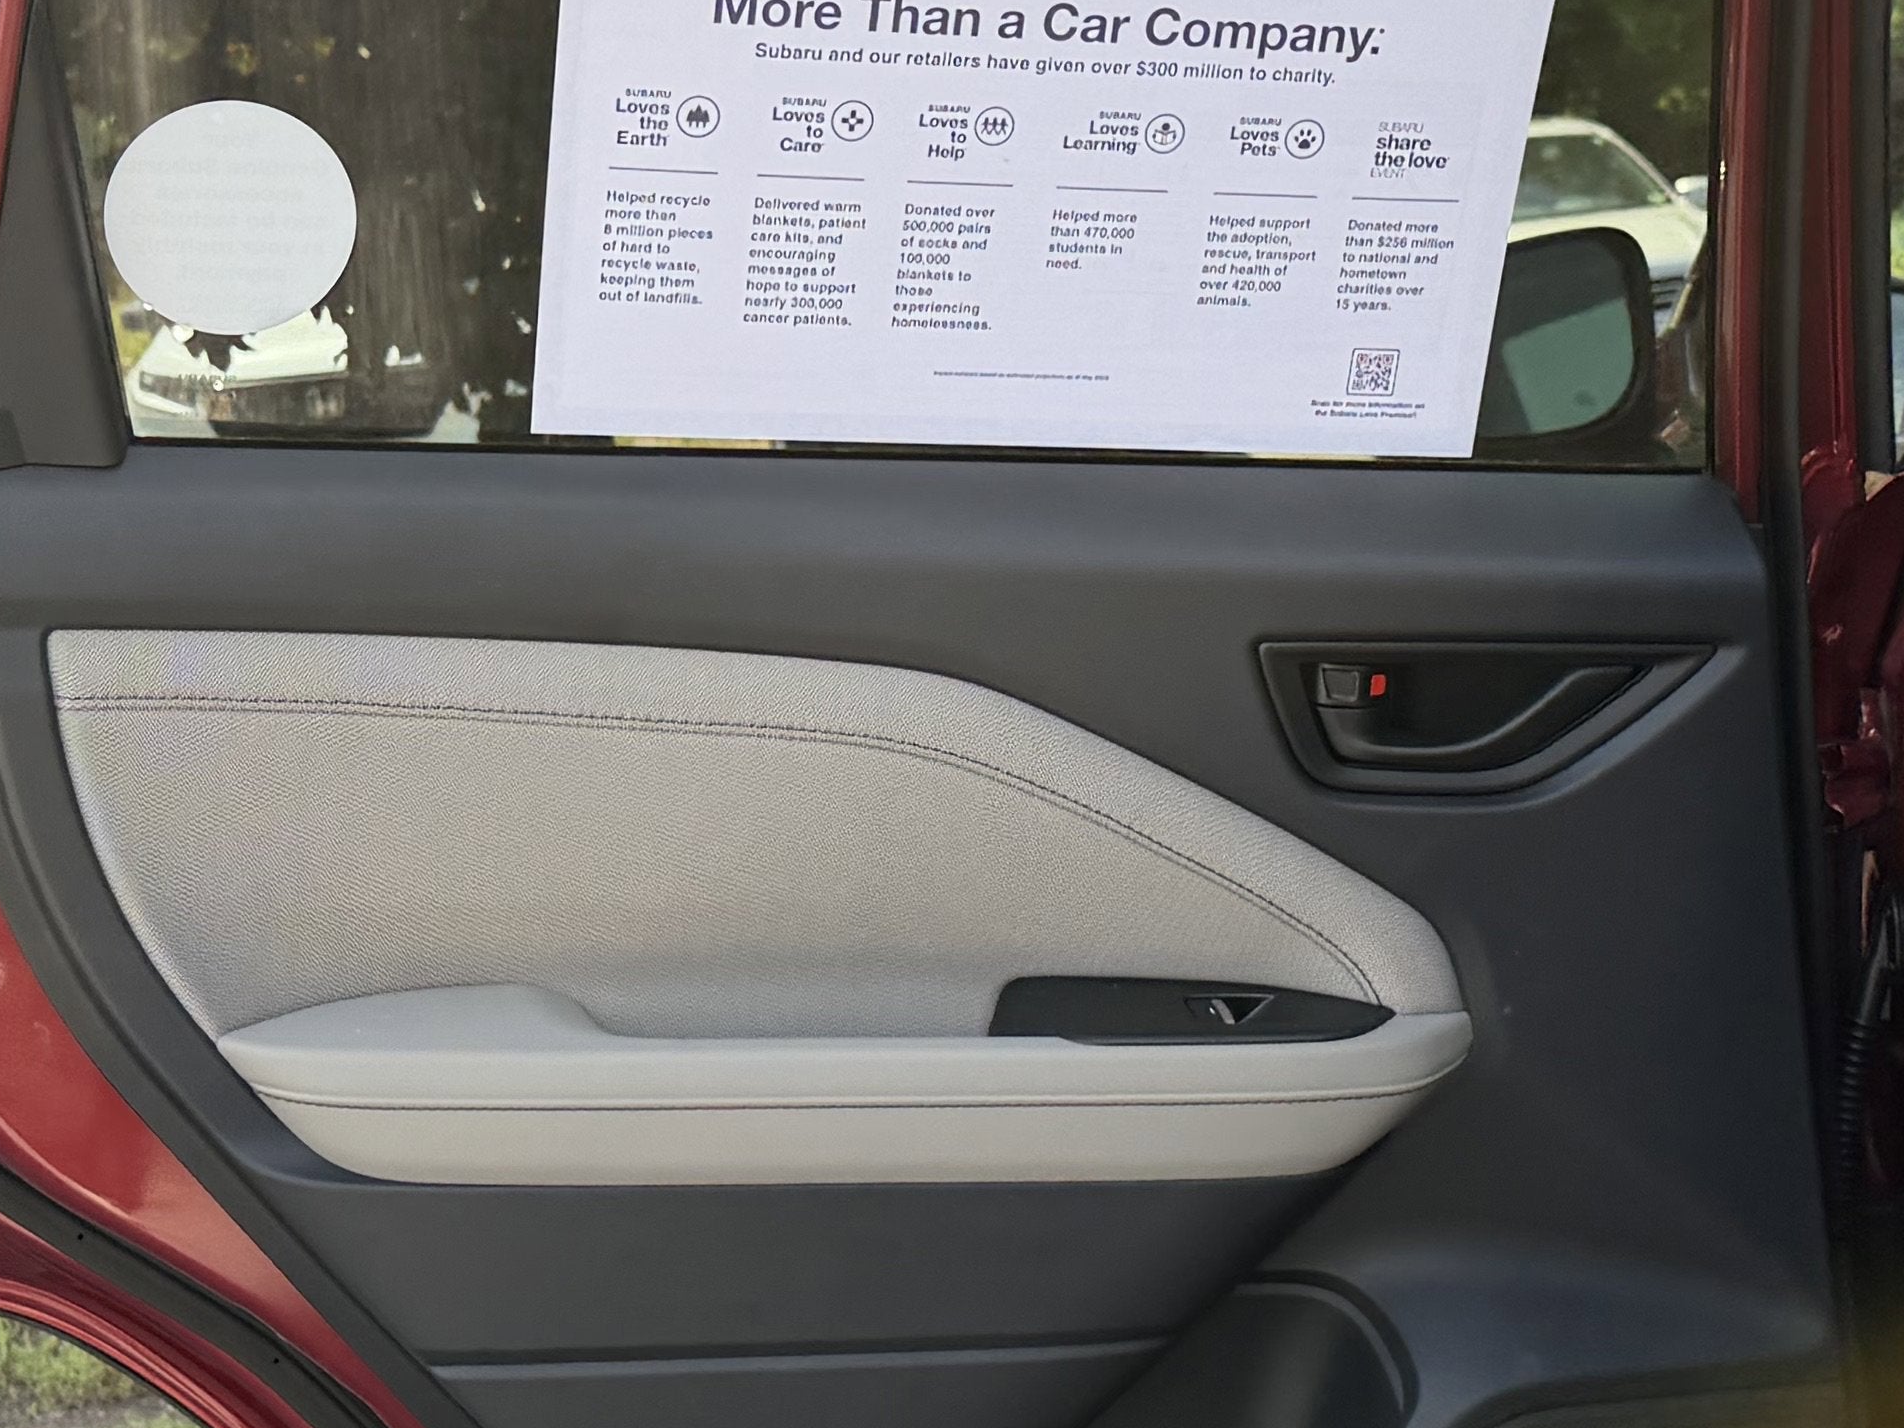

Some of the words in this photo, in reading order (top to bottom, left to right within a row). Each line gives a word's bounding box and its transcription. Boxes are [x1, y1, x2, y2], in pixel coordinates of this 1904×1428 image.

[998, 11, 1024, 38] a
[1044, 3, 1130, 43] Car
[1146, 8, 1384, 62] Company.
[756, 43, 822, 60] Subaru
[829, 48, 863, 62] and
[870, 52, 900, 63] our
[907, 52, 980, 68] retailers
[988, 54, 1029, 70] have
[1036, 58, 1084, 74] given
[1092, 62, 1131, 74] over
[1137, 61, 1178, 76] $300
[1184, 64, 1242, 80] million
[1250, 67, 1266, 80] to
[1273, 68, 1334, 86] charity.
[626, 88, 671, 98] SUBARU
[616, 98, 669, 114] Loves
[783, 97, 826, 107] SUBARU
[773, 107, 824, 123] Loves
[928, 105, 970, 113] SUBARU
[1100, 111, 1141, 120] SUBARU
[640, 117, 668, 130] the
[919, 114, 968, 128] Loves
[1240, 117, 1282, 126] SUBARU
[1379, 122, 1424, 133] SUBARU
[807, 126, 823, 138] to
[1090, 120, 1138, 136] Loves
[1230, 126, 1278, 141] Loves
[617, 131, 666, 146] Earth
[951, 131, 966, 143] to
[1376, 134, 1431, 150] share
[780, 138, 822, 152] Care
[1064, 136, 1137, 155] Learning
[1241, 142, 1276, 156] Pets
[928, 144, 964, 161] Help
[1375, 152, 1405, 167] the
[1408, 152, 1446, 168] love
[1370, 168, 1405, 178] EVENT
[607, 190, 656, 204] Helped
[661, 196, 710, 208] recycle
[755, 198, 820, 210] Delivered
[824, 204, 860, 212] warm
[605, 210, 641, 219] more
[646, 210, 676, 220] than
[905, 204, 961, 216] Donated
[966, 209, 994, 217] over
[1053, 210, 1099, 223] Helped
[1104, 214, 1137, 222] more
[753, 214, 814, 228] blankets,
[819, 218, 866, 230] patient
[903, 220, 954, 232] 500,000
[958, 223, 990, 235] pairs
[1210, 216, 1255, 229] Helped
[1260, 219, 1310, 231] support
[1348, 220, 1402, 231] Donated
[1406, 224, 1438, 232] more
[604, 224, 611, 234] 8
[616, 225, 663, 236] million
[668, 228, 712, 240] pieces
[751, 233, 780, 242] care
[785, 232, 812, 244] kits,
[818, 234, 842, 244] and
[1051, 226, 1079, 236] than
[1084, 227, 1134, 239] 470,000
[901, 236, 914, 246] of
[919, 238, 957, 249] socks
[962, 239, 987, 250] and
[1208, 232, 1227, 242] the
[1231, 232, 1291, 246] adoption,
[1346, 236, 1373, 246] than
[1411, 238, 1454, 249] million
[603, 241, 616, 250] of
[621, 242, 652, 253] hard
[658, 244, 670, 254] to
[1049, 243, 1106, 254] students
[1111, 244, 1122, 254] in
[750, 250, 835, 263] encouraging
[901, 253, 950, 264] 100,000
[1204, 250, 1251, 261] rescue,
[1256, 250, 1316, 262] transport
[1343, 252, 1355, 262] to
[1359, 253, 1410, 263] national
[1414, 254, 1438, 264] and
[602, 258, 651, 272] recycle
[656, 262, 699, 273] waste,
[1046, 259, 1081, 269] need.
[1202, 264, 1226, 274] and
[1230, 264, 1270, 276] health
[1274, 265, 1287, 276] of
[748, 266, 816, 278] messages
[822, 266, 835, 276] of
[897, 269, 953, 280] blankets
[959, 271, 971, 281] to
[1340, 267, 1406, 279] hometown
[601, 273, 655, 288] keeping
[660, 276, 694, 287] them
[1200, 281, 1228, 290] over
[1232, 280, 1281, 292] 420,000
[747, 280, 780, 293] hope
[785, 282, 798, 292] to
[804, 284, 856, 295] support
[896, 285, 932, 296] those
[1338, 283, 1391, 295] charities
[1396, 287, 1424, 295] over
[599, 291, 621, 300] out
[626, 291, 639, 301] of
[644, 292, 702, 304] landfills.
[745, 297, 786, 310] nearly
[791, 297, 842, 309] 300,000
[1197, 296, 1250, 306] animals.
[894, 302, 980, 316] experiencing
[1337, 299, 1349, 310] 15
[1354, 302, 1390, 312] years.
[744, 314, 789, 323] cancer
[794, 314, 851, 326] patients.
[892, 316, 991, 330] homelessness.
